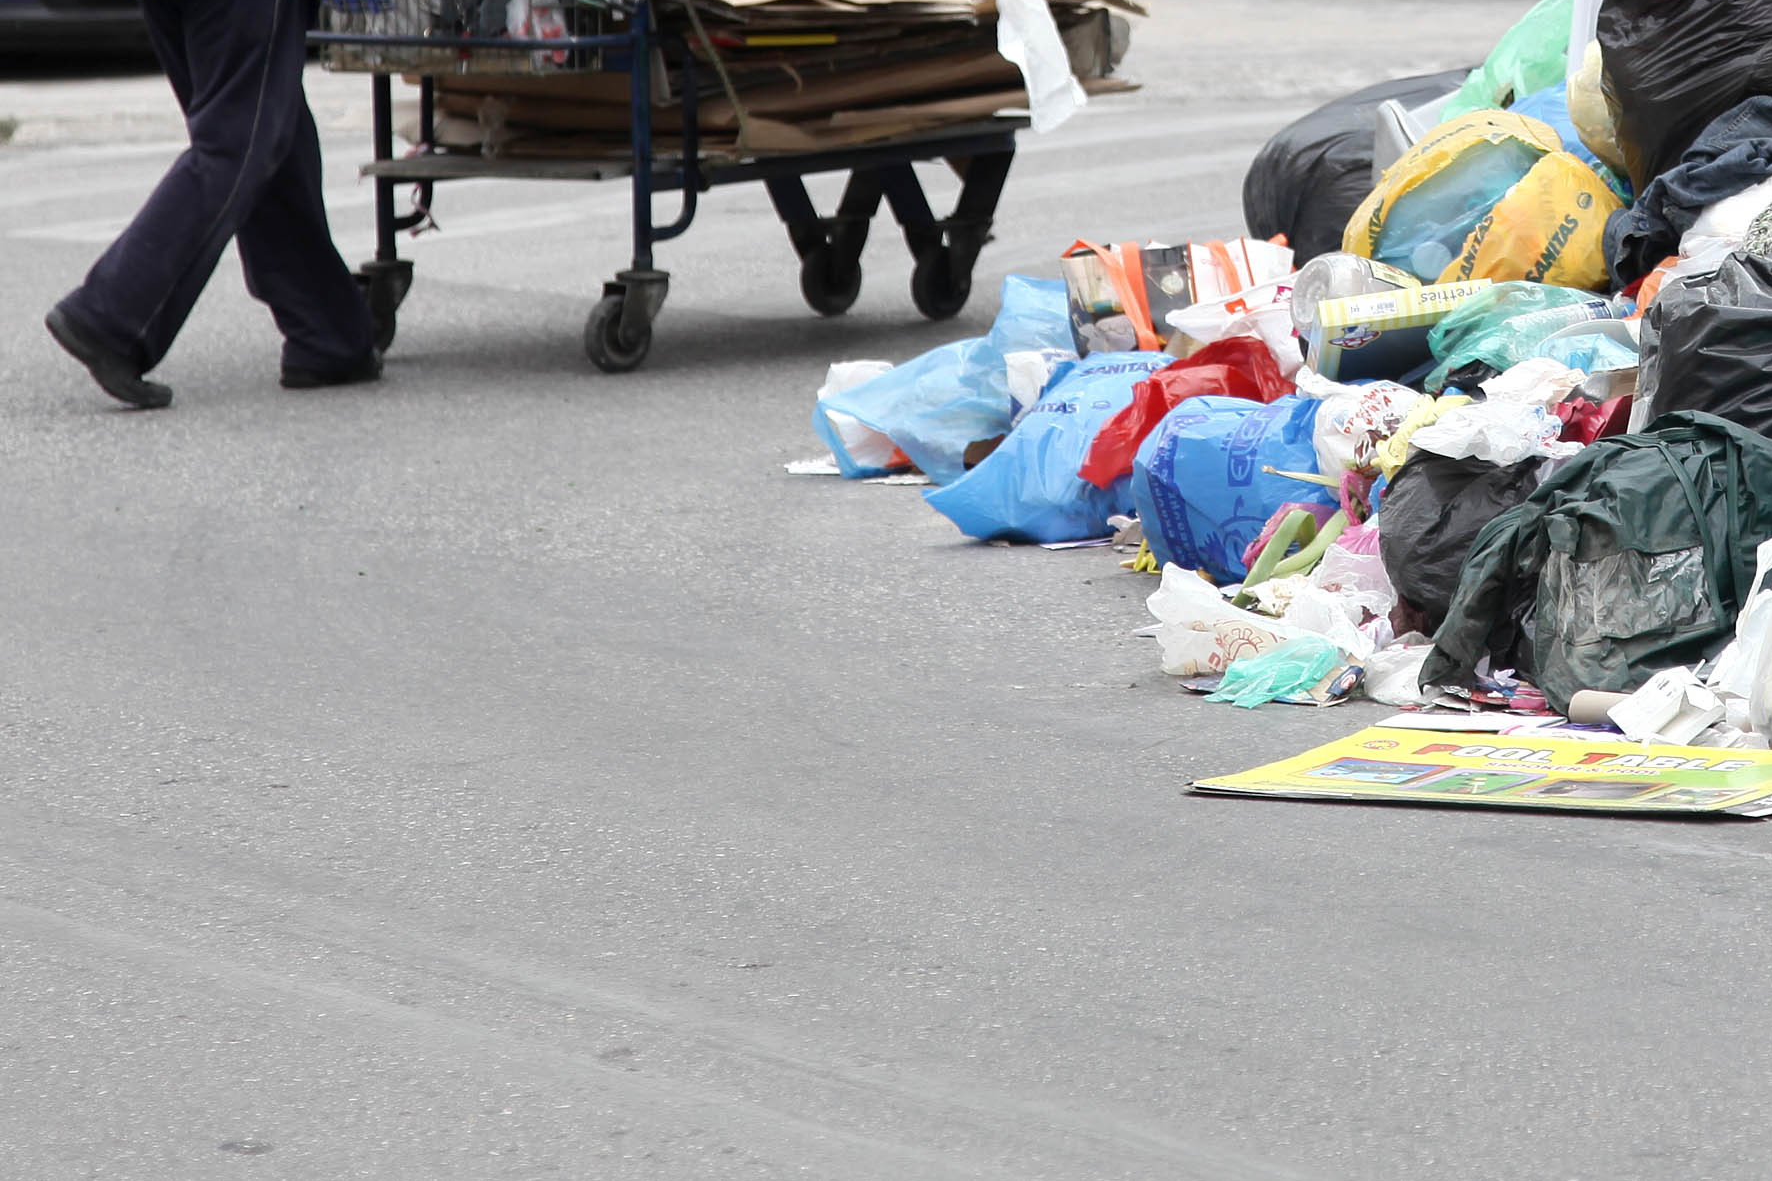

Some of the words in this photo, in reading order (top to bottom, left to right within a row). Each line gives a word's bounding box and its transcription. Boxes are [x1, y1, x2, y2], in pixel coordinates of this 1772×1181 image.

[1525, 213, 1579, 284] SANITAS
[1420, 286, 1481, 304] retties
[1411, 743, 1555, 765] POOL
[1574, 753, 1753, 772] TABLE
[1484, 760, 1584, 775] SNOOKER
